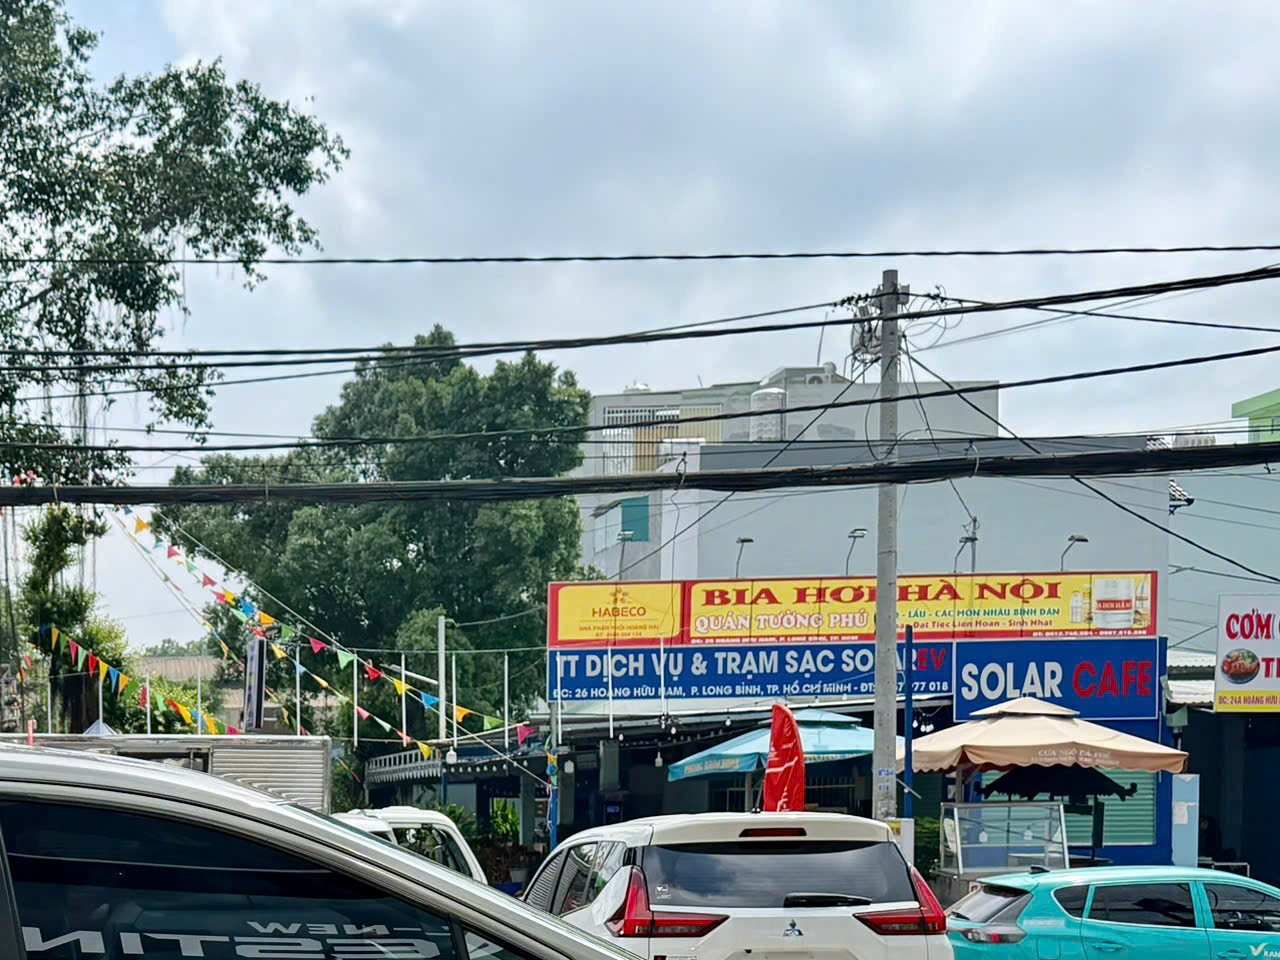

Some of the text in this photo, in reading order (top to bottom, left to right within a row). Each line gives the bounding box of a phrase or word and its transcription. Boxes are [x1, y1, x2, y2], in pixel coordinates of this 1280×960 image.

[702, 587, 782, 606] BIA
[898, 579, 964, 600] HÀ
[975, 578, 1061, 603] NỘI
[592, 606, 647, 617] HABECO
[695, 609, 869, 633] QUÁN TƯỜNG PHÚ
[1226, 608, 1273, 640] CƠM
[585, 653, 644, 682] DỊCH
[651, 653, 683, 681] VỤ
[691, 652, 708, 676] &
[715, 650, 778, 680] TRẠM
[785, 648, 835, 678] SẠC
[575, 688, 588, 698] 26
[634, 685, 655, 697] HỮU
[691, 686, 700, 696] P.
[702, 685, 732, 695] LONG
[735, 682, 764, 696] BÌNH,
[766, 684, 780, 694] TP.
[929, 681, 948, 691] 018
[961, 661, 1152, 700] SOLAR CAFE
